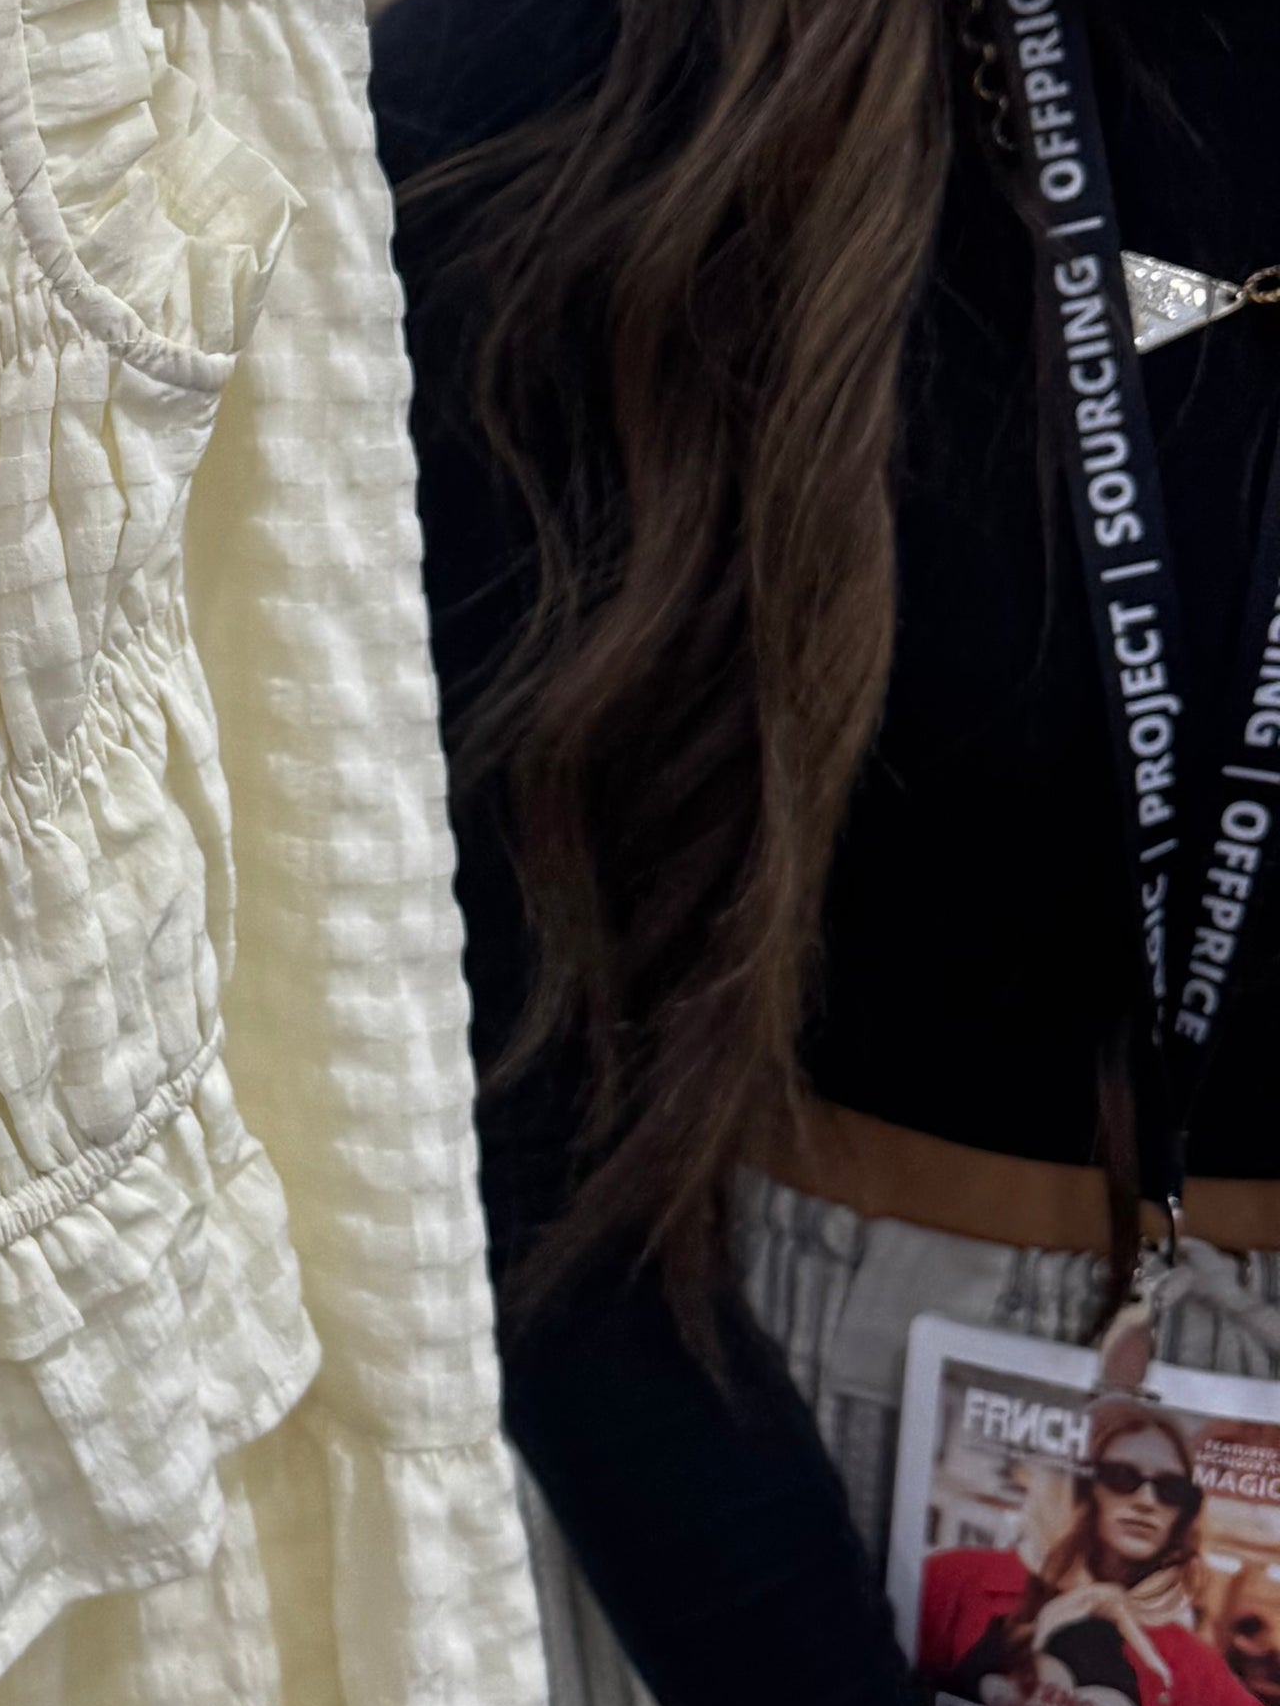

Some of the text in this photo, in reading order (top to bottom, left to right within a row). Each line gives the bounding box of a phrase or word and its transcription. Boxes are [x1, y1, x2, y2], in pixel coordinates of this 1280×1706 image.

[1054, 253, 1142, 547] SOURCING
[1108, 600, 1182, 826] PROJECT
[1174, 799, 1272, 1045] OFFPRICE
[1192, 1464, 1280, 1502] MAGIC
